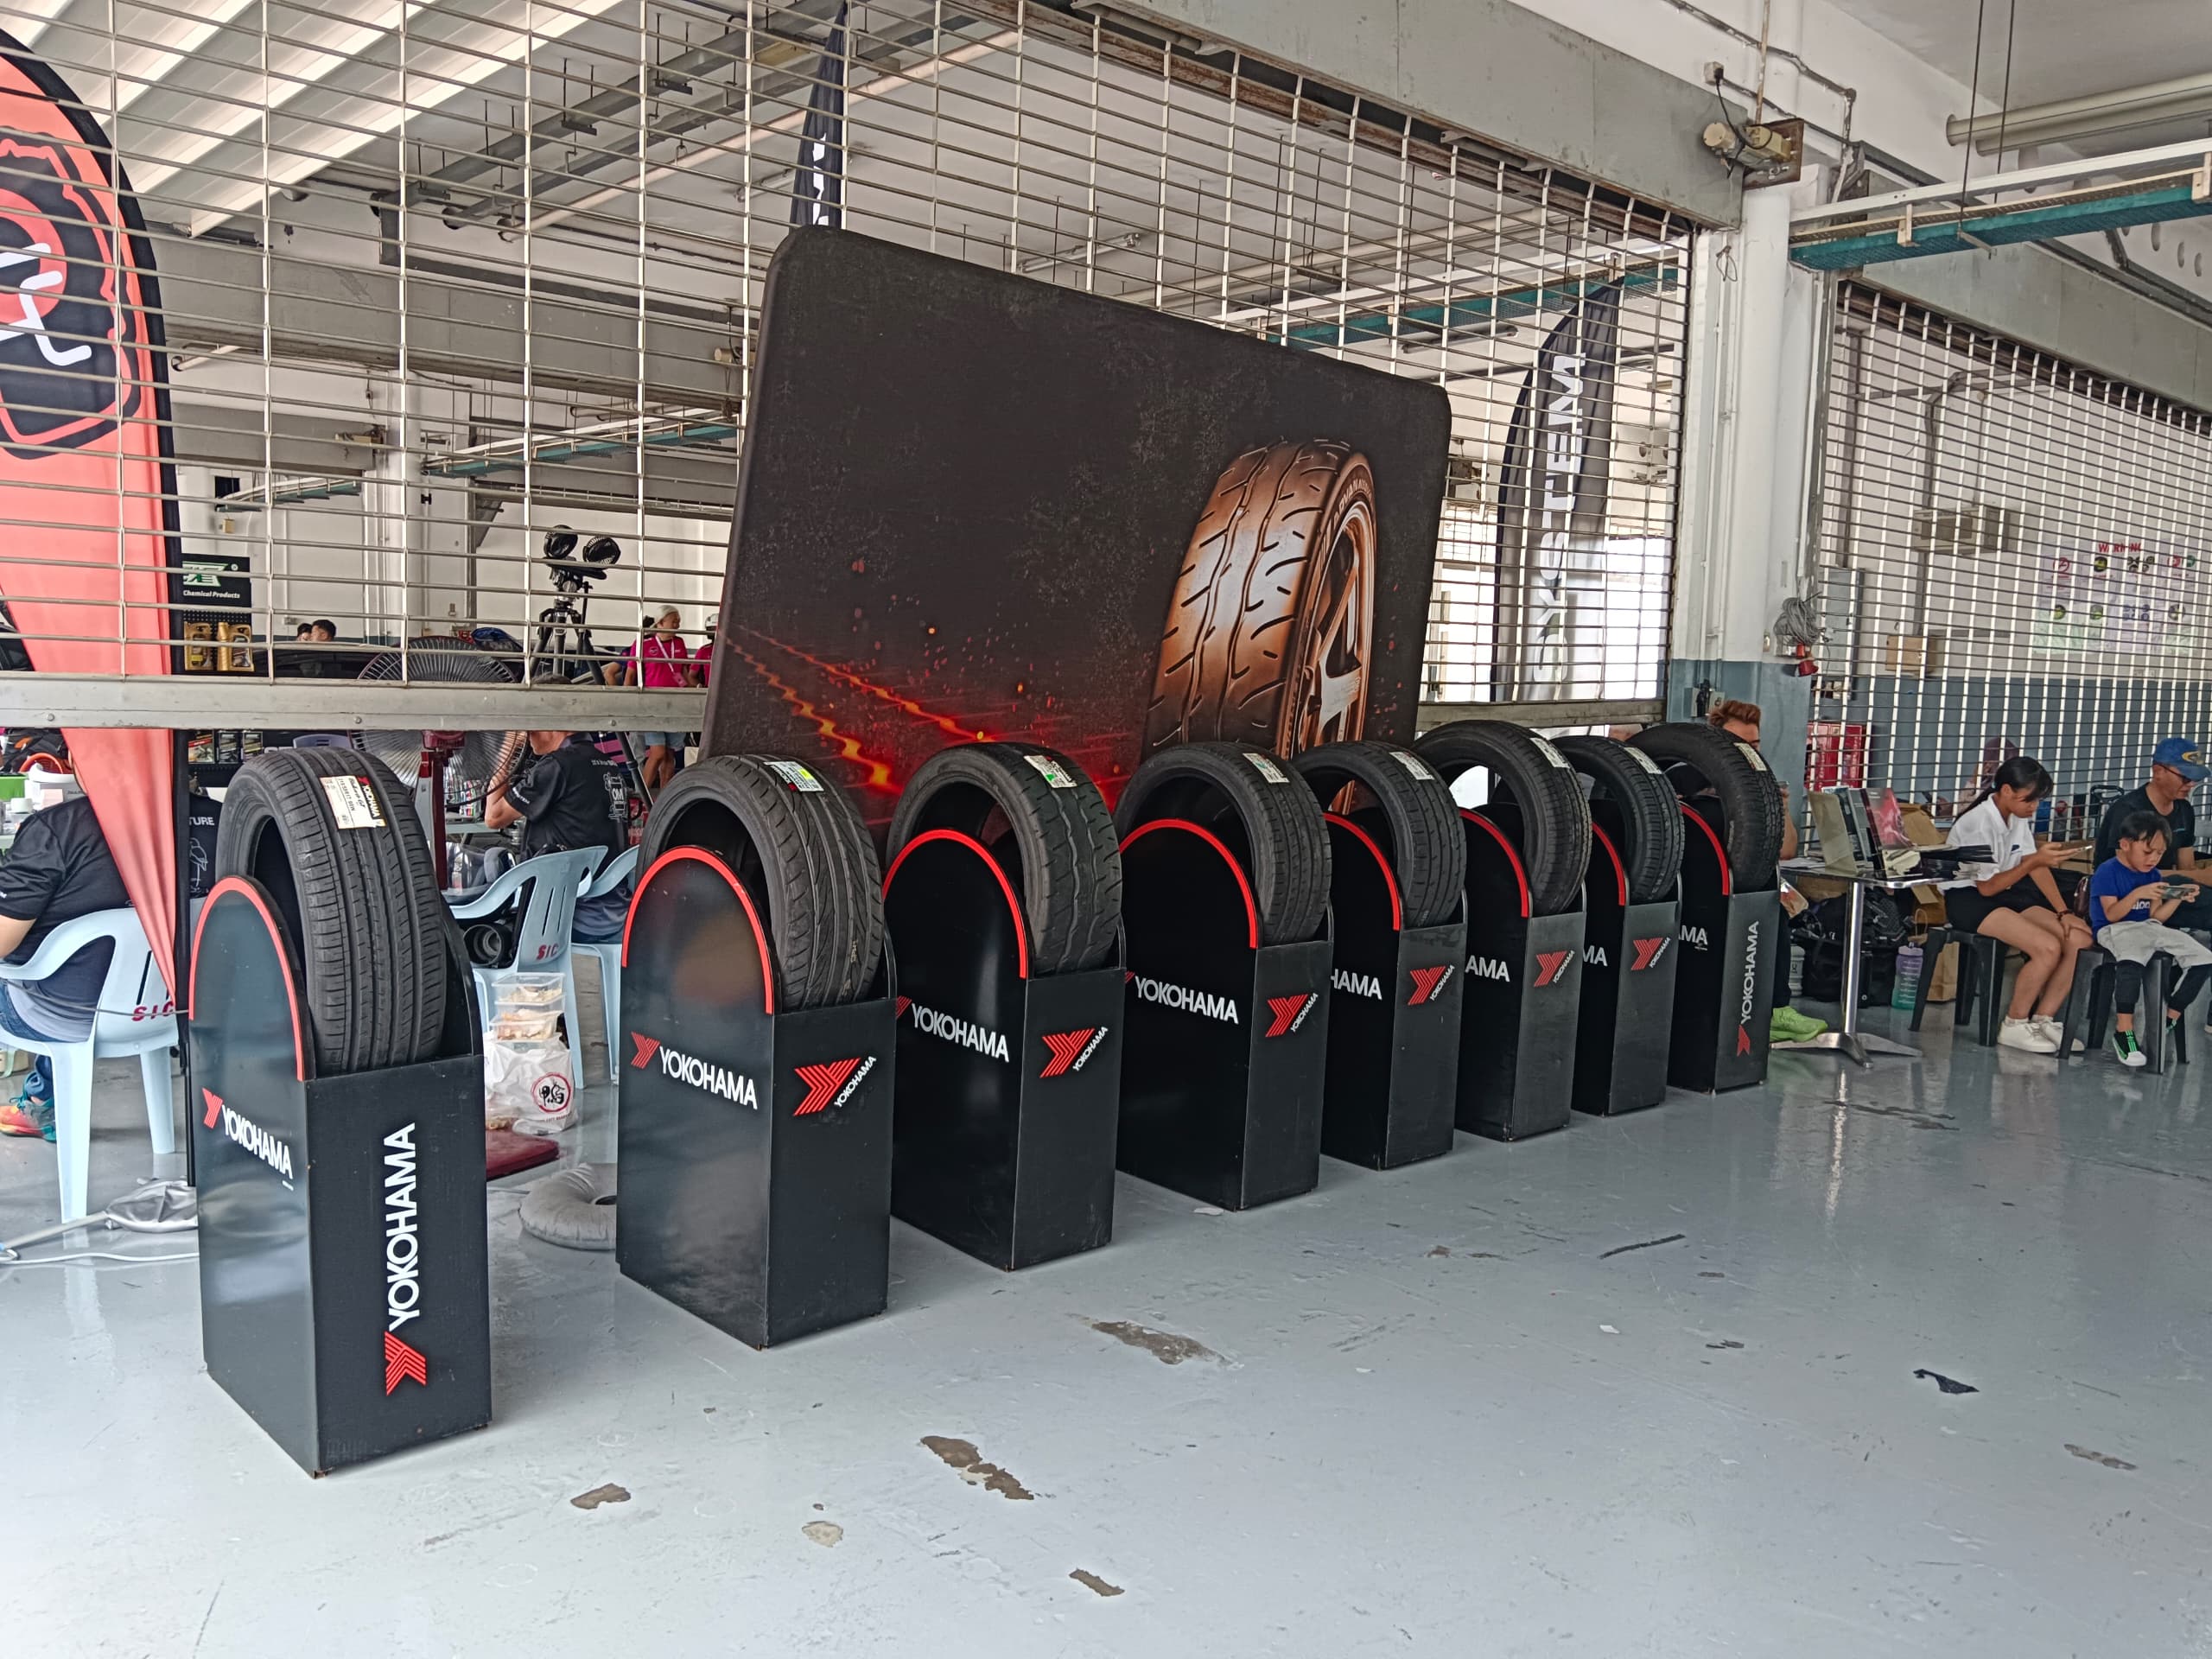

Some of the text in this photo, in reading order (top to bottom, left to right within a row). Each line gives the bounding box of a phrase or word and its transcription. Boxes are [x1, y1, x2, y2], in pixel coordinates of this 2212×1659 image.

[1649, 937, 1671, 968] YOKOHAMA
[1679, 925, 1708, 945] MA
[1429, 964, 1455, 1001] YOKOHAMA
[1553, 950, 1575, 983] YOKOHAMA
[1740, 920, 1759, 1025] YOKOHAMA
[1135, 975, 1239, 1025] YOKOHAMA
[1290, 992, 1319, 1033] YOKOHAMA
[912, 1002, 1009, 1063] YOKOHAMA
[1072, 1026, 1109, 1071] YOKOHAMA
[659, 1046, 759, 1110] YOKOHAMA
[833, 1055, 877, 1108] YOKOHAMA
[221, 1104, 293, 1179] YOKOHAMA
[383, 1122, 421, 1332] YOKOHAMA
